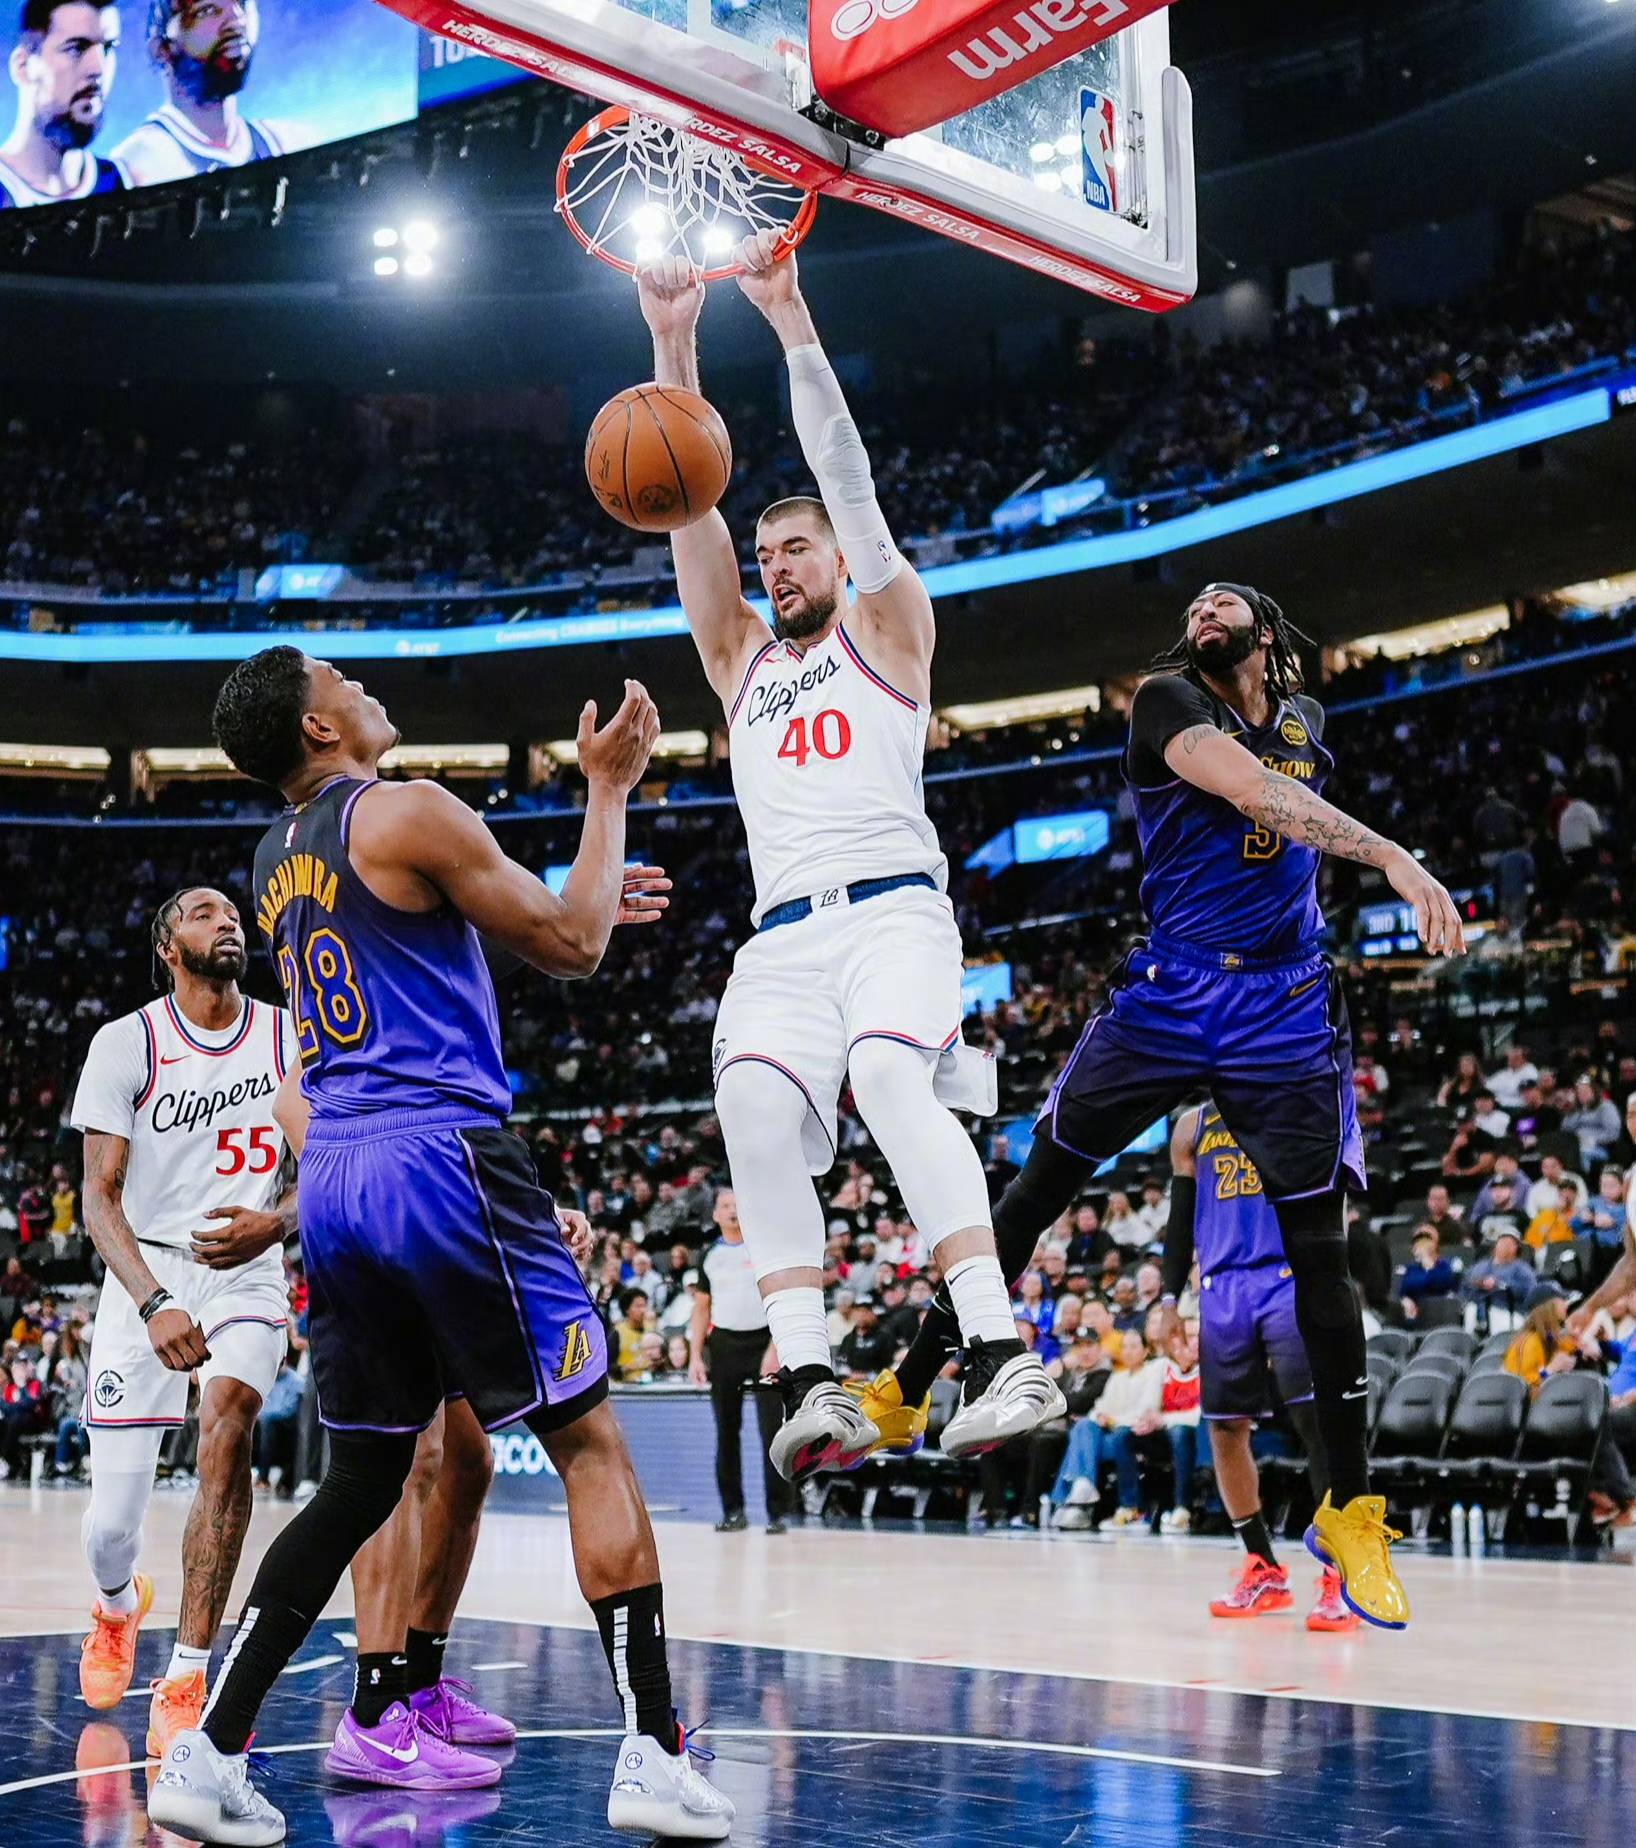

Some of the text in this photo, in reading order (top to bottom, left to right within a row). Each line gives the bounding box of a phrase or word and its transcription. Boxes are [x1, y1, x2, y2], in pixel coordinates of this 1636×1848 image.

[738, 138, 802, 174] SALSA
[1086, 180, 1106, 206] NBA
[923, 213, 981, 240] SALSA
[748, 655, 841, 727] Clippers
[777, 708, 851, 767] 40
[277, 927, 368, 1056] 28
[151, 1072, 276, 1133] Clippers
[215, 1126, 278, 1177] 55
[1214, 1152, 1263, 1200] 23
[553, 1320, 593, 1382] LA
